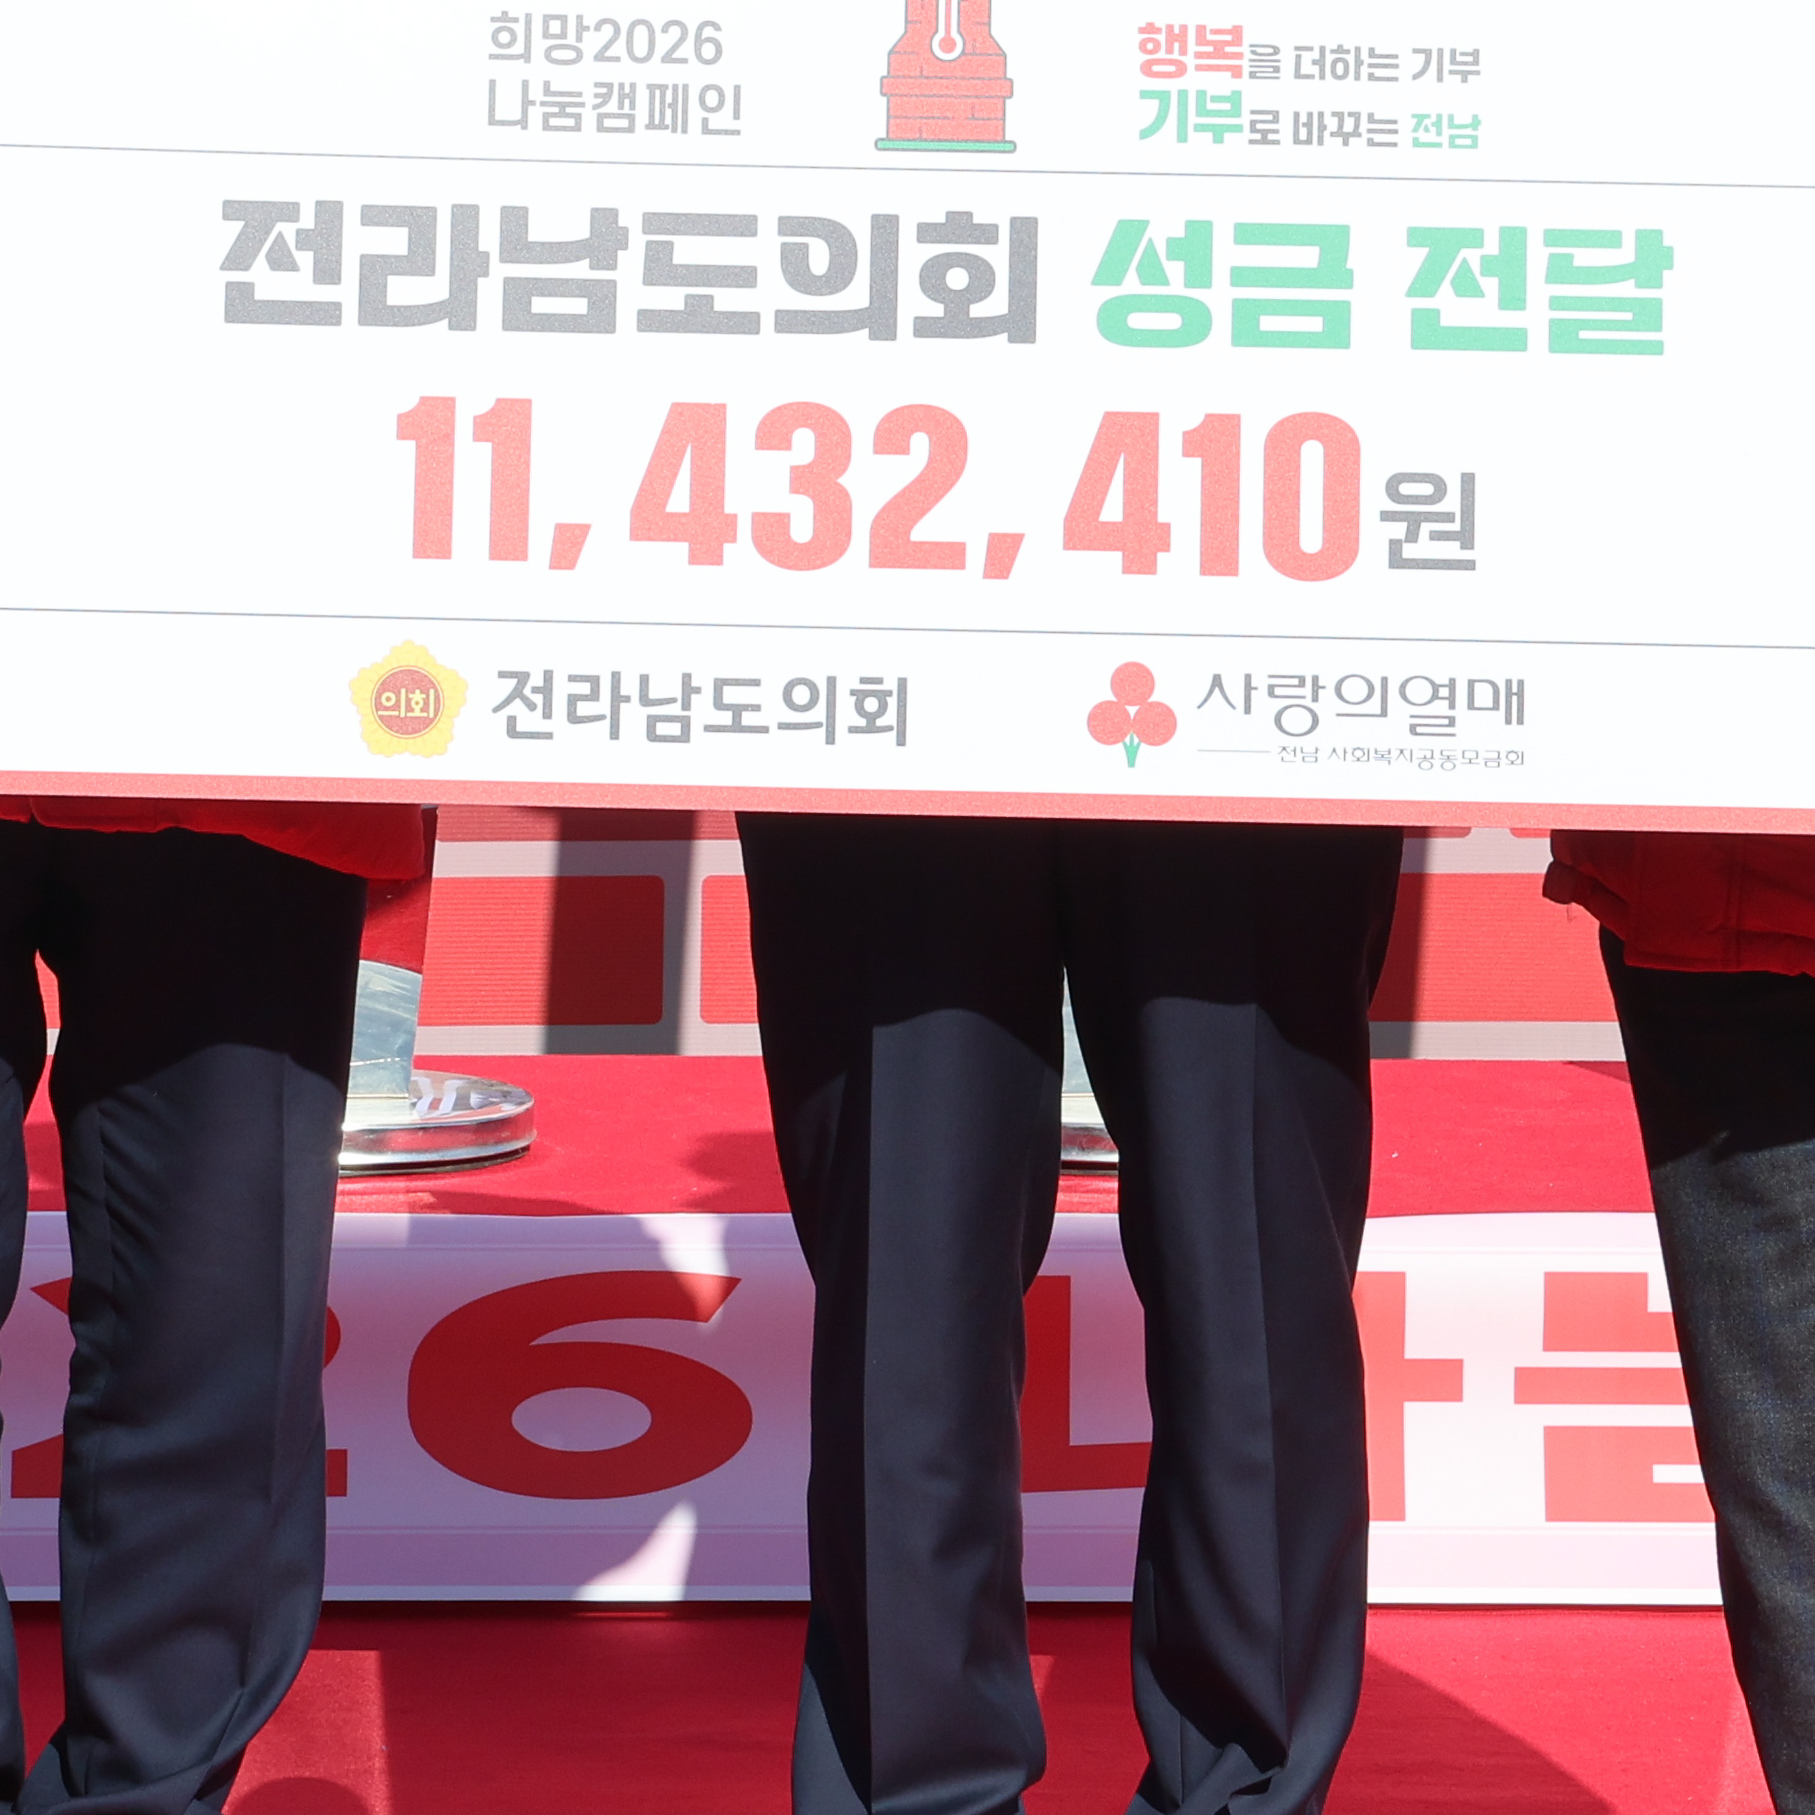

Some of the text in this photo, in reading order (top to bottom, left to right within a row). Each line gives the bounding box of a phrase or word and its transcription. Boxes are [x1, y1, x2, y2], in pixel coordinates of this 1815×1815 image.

[488, 11, 724, 67] 희망2026
[1138, 22, 1482, 84] 행복을 더하는 기부
[488, 78, 743, 137] 나눔캠페인
[1139, 89, 1483, 150] 기부로 바꾸는 전남
[219, 200, 1676, 358] 전라남도의회 성금 전달
[378, 689, 435, 720] 의회
[492, 670, 909, 749] 전라남도의회
[1197, 673, 1526, 739] 사랑의열매
[1279, 745, 1526, 772] 전남 사회복지공동모금회
